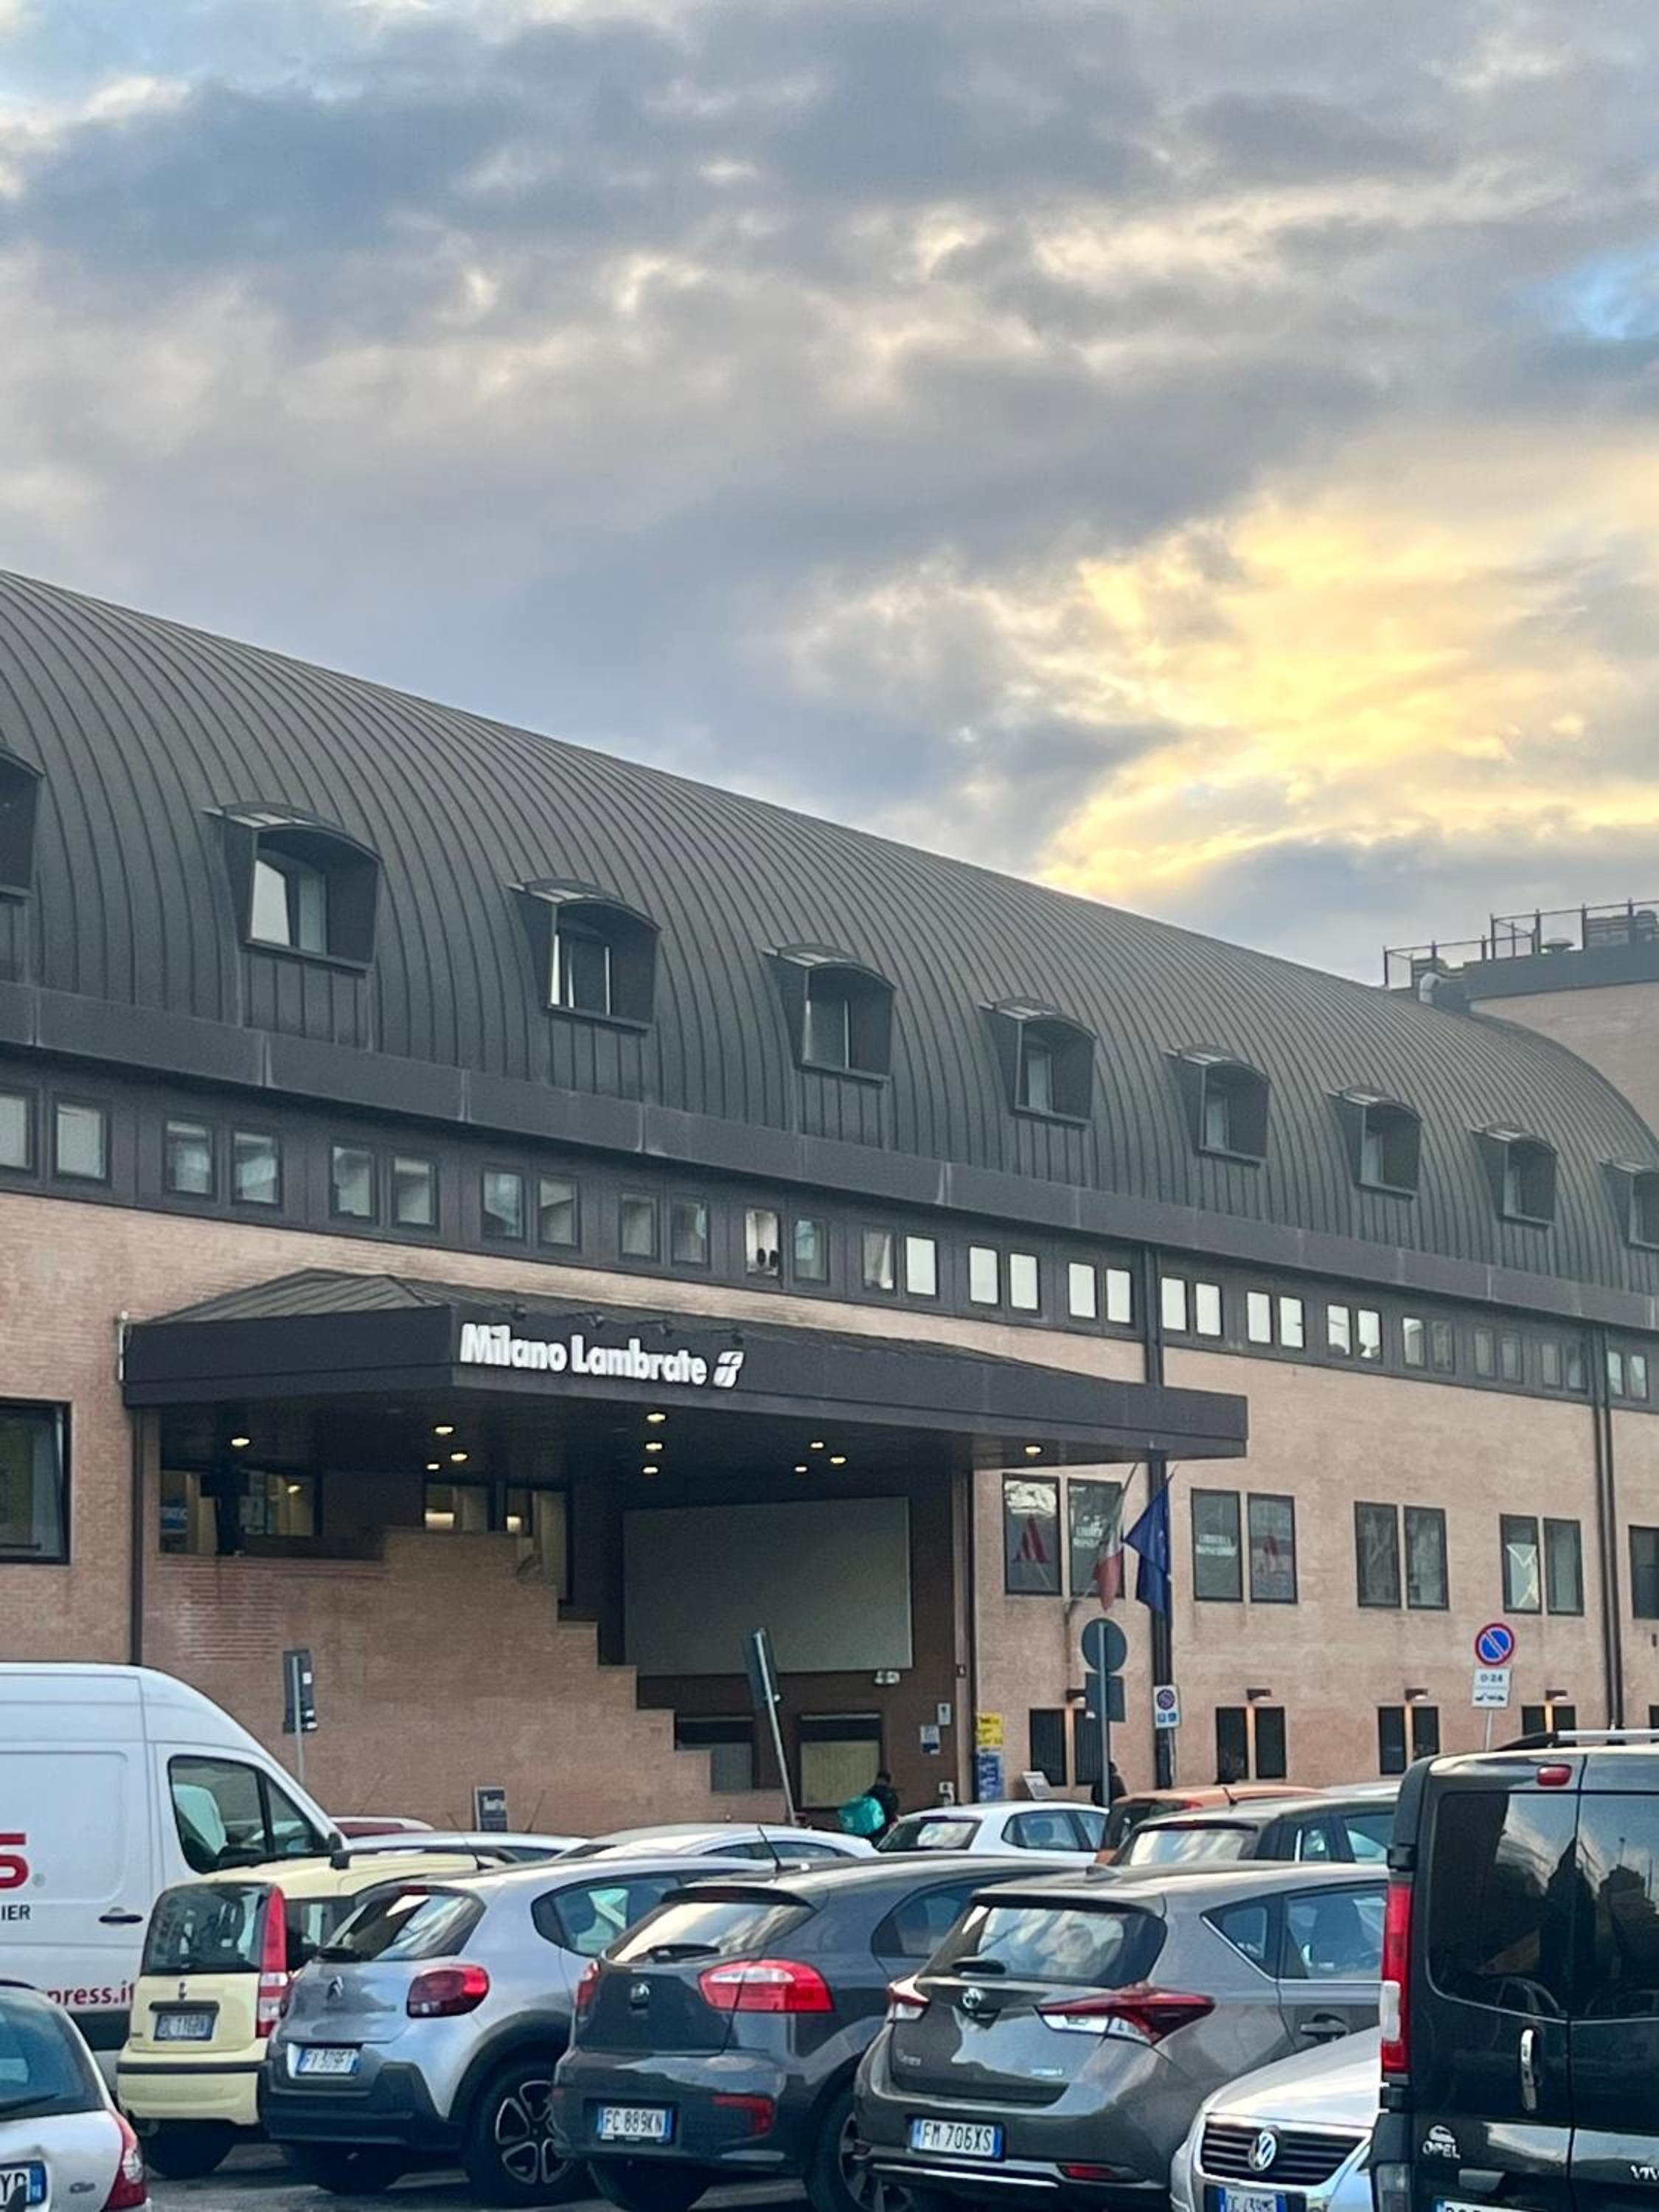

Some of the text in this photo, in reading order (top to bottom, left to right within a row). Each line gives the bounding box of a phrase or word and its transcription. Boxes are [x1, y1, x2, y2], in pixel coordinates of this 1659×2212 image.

[459, 1323, 708, 1385] Milano Lambrate
[923, 2122, 992, 2152] FM 706XS
[1422, 2140, 1461, 2160] OPEL
